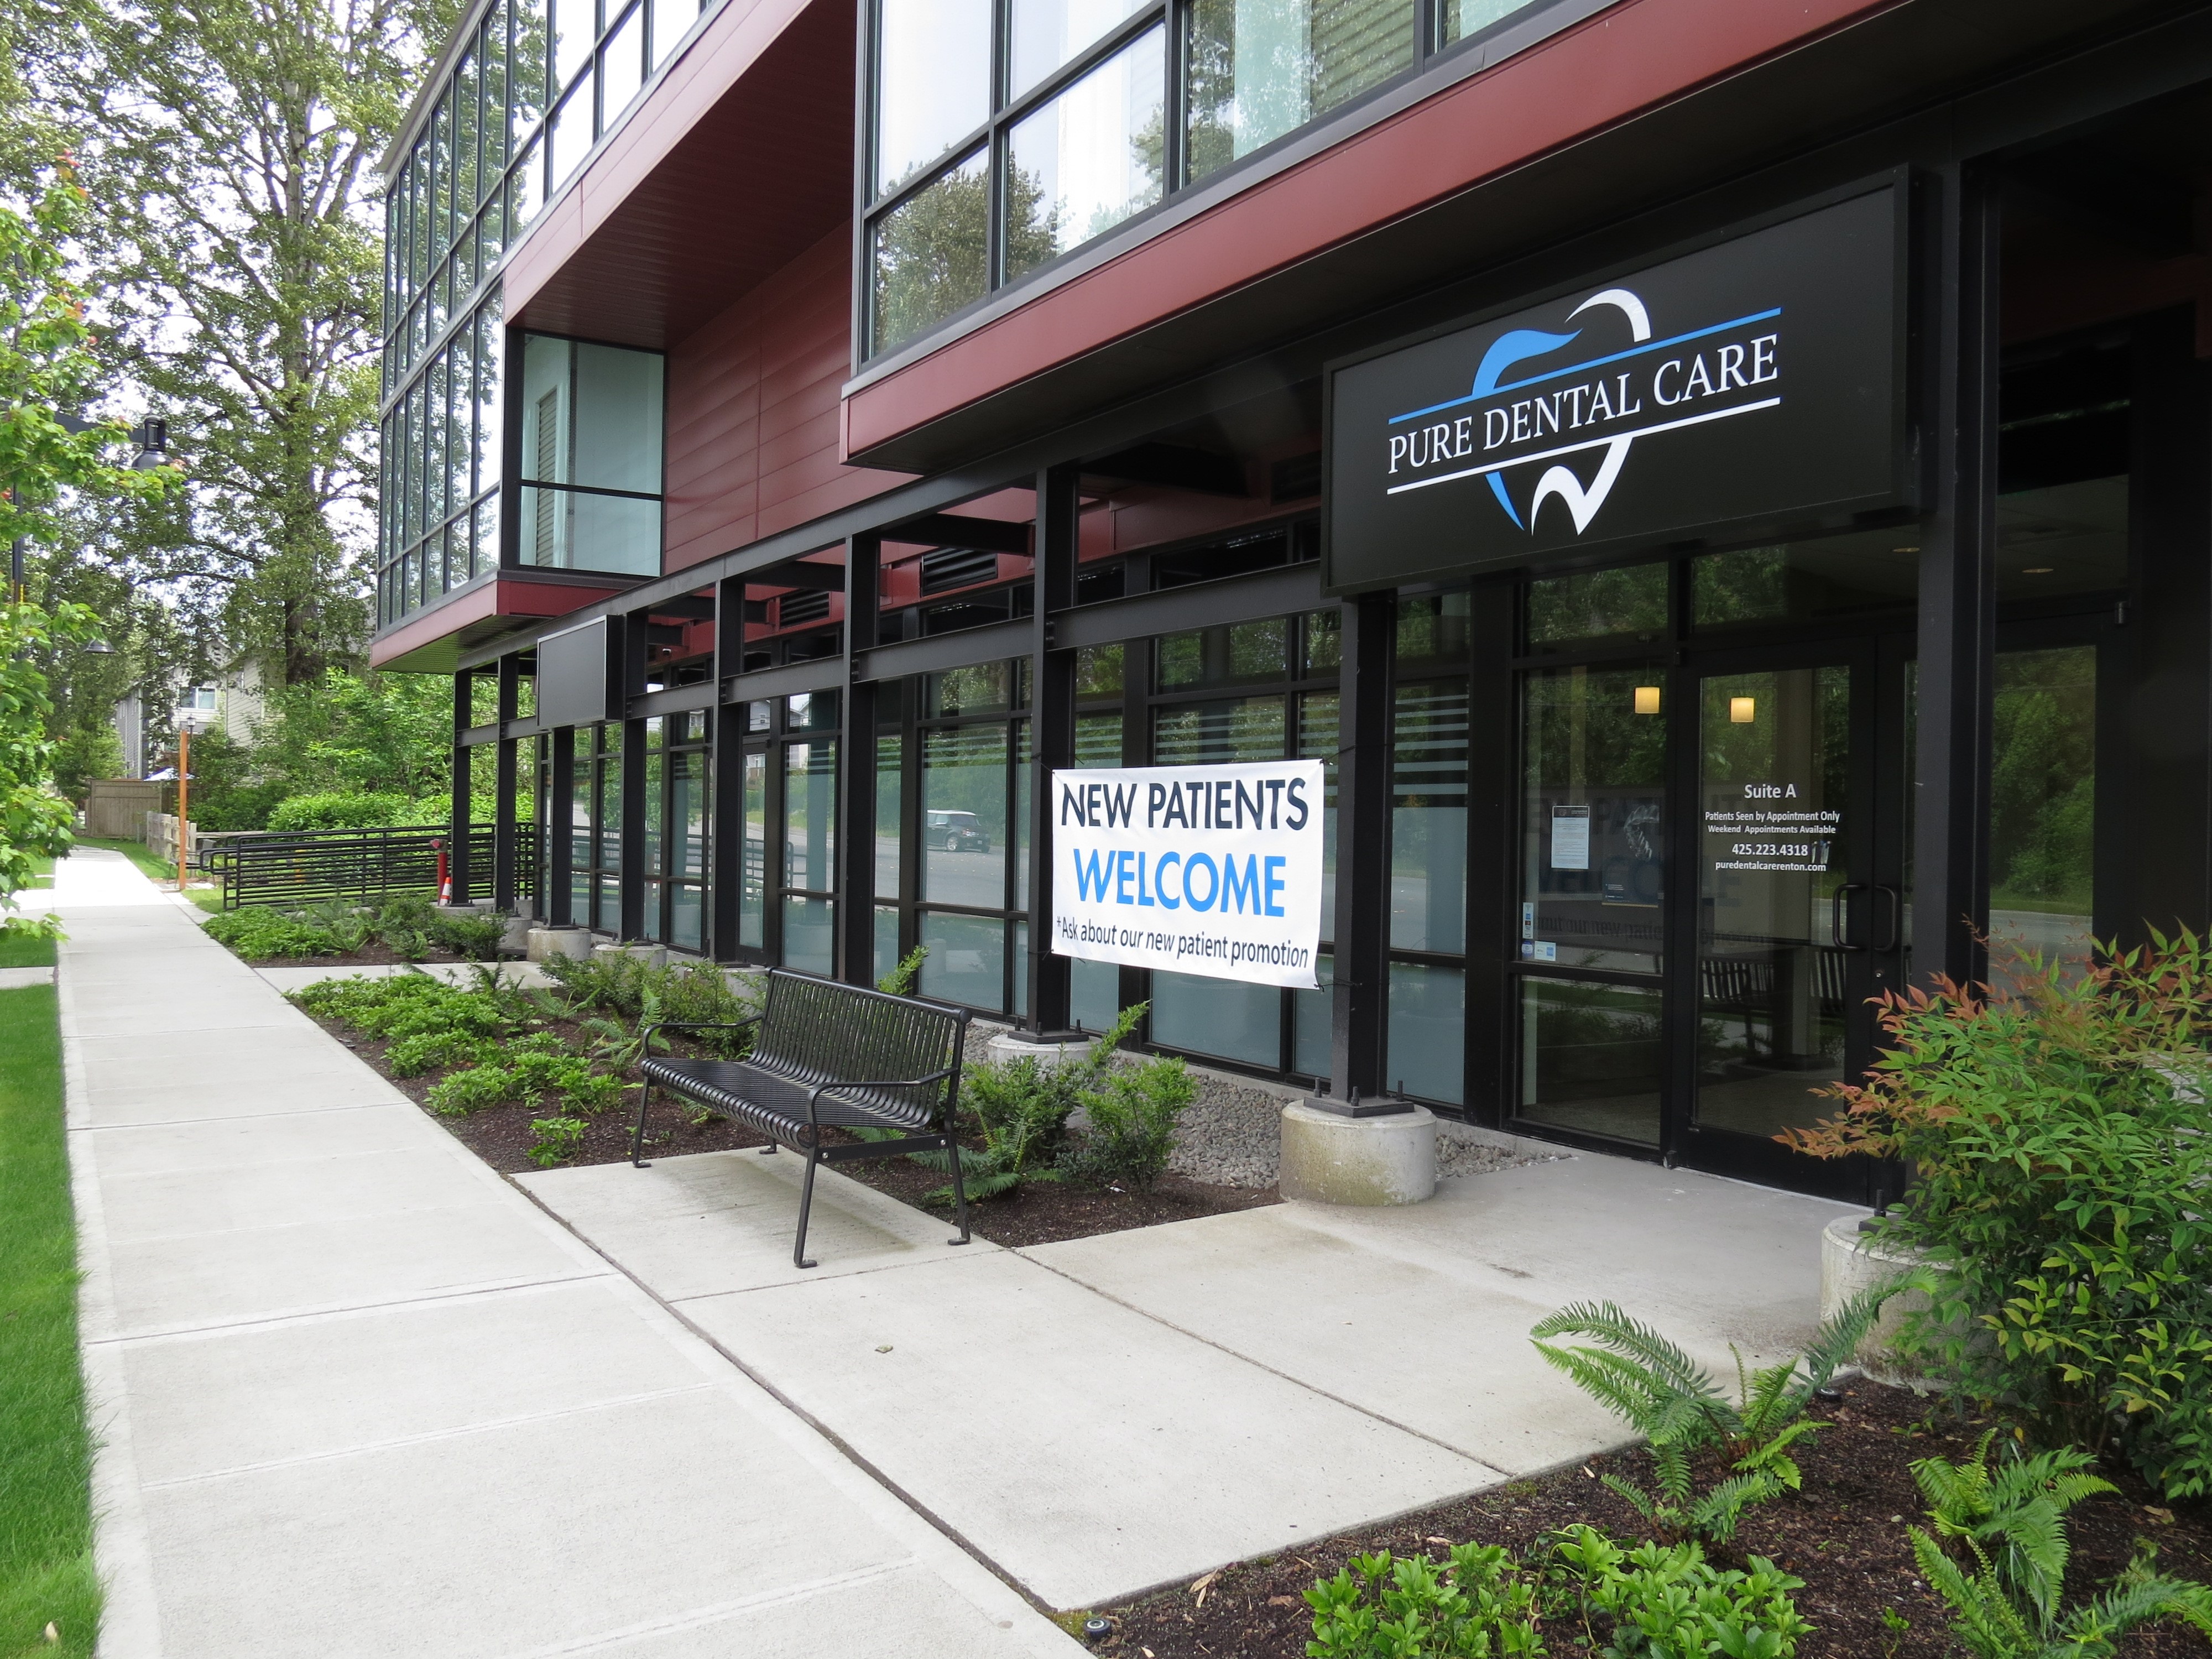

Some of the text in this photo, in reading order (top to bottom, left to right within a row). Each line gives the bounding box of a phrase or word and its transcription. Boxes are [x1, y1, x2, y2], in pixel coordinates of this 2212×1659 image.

[1388, 333, 1778, 474] PURE DENTAL CARE
[1744, 784, 1796, 799] Suite A
[1061, 778, 1308, 831] NEW PATIENTS
[1705, 811, 1840, 823] Patients Seen by Appointment Only
[1744, 825, 1797, 834] Appointments
[1799, 825, 1836, 834] Available
[1732, 844, 1808, 856] 425.223.4318
[1715, 860, 1826, 872] puredentalcarerenton.com
[1073, 848, 1286, 917] WELCOME
[1081, 919, 1117, 945] about
[1120, 929, 1144, 948] our
[1145, 932, 1175, 952] new
[1177, 931, 1228, 959] patient
[1231, 940, 1308, 968] promotion
